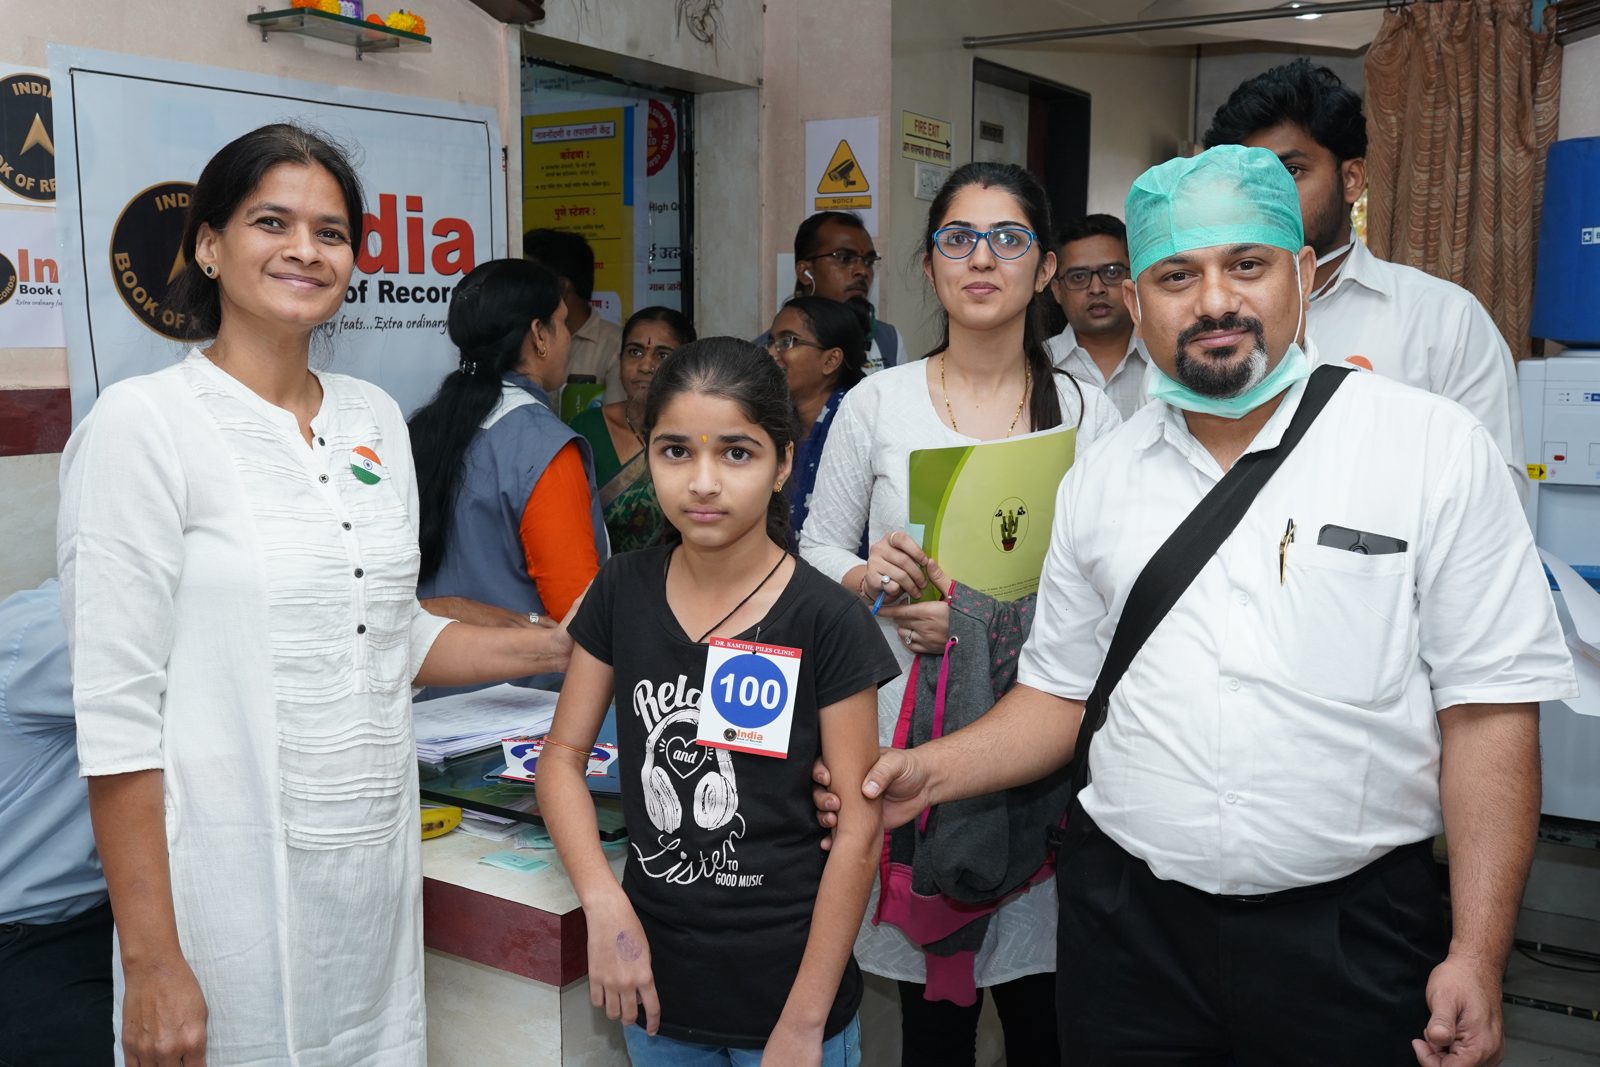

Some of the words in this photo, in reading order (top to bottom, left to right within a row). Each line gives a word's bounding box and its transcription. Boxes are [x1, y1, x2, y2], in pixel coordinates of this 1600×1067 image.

[914, 119, 928, 136] FIRE
[928, 122, 941, 138] EXIT
[15, 173, 35, 190] OF
[569, 204, 590, 217] स्टेशन
[648, 202, 669, 213] High
[19, 284, 53, 296] Book
[114, 252, 159, 317] BOOK
[162, 310, 185, 329] OF
[344, 280, 368, 303] of
[378, 280, 458, 304] Recor
[726, 641, 754, 651] KAMTHE
[755, 646, 773, 654] PILES
[773, 649, 795, 657] CLINIC
[720, 673, 781, 710] 100
[737, 729, 763, 741] India
[673, 749, 698, 764] and
[631, 812, 746, 885] Listen
[727, 859, 739, 871] TO
[715, 872, 737, 888] GOOD
[738, 874, 764, 888] MUSIC
